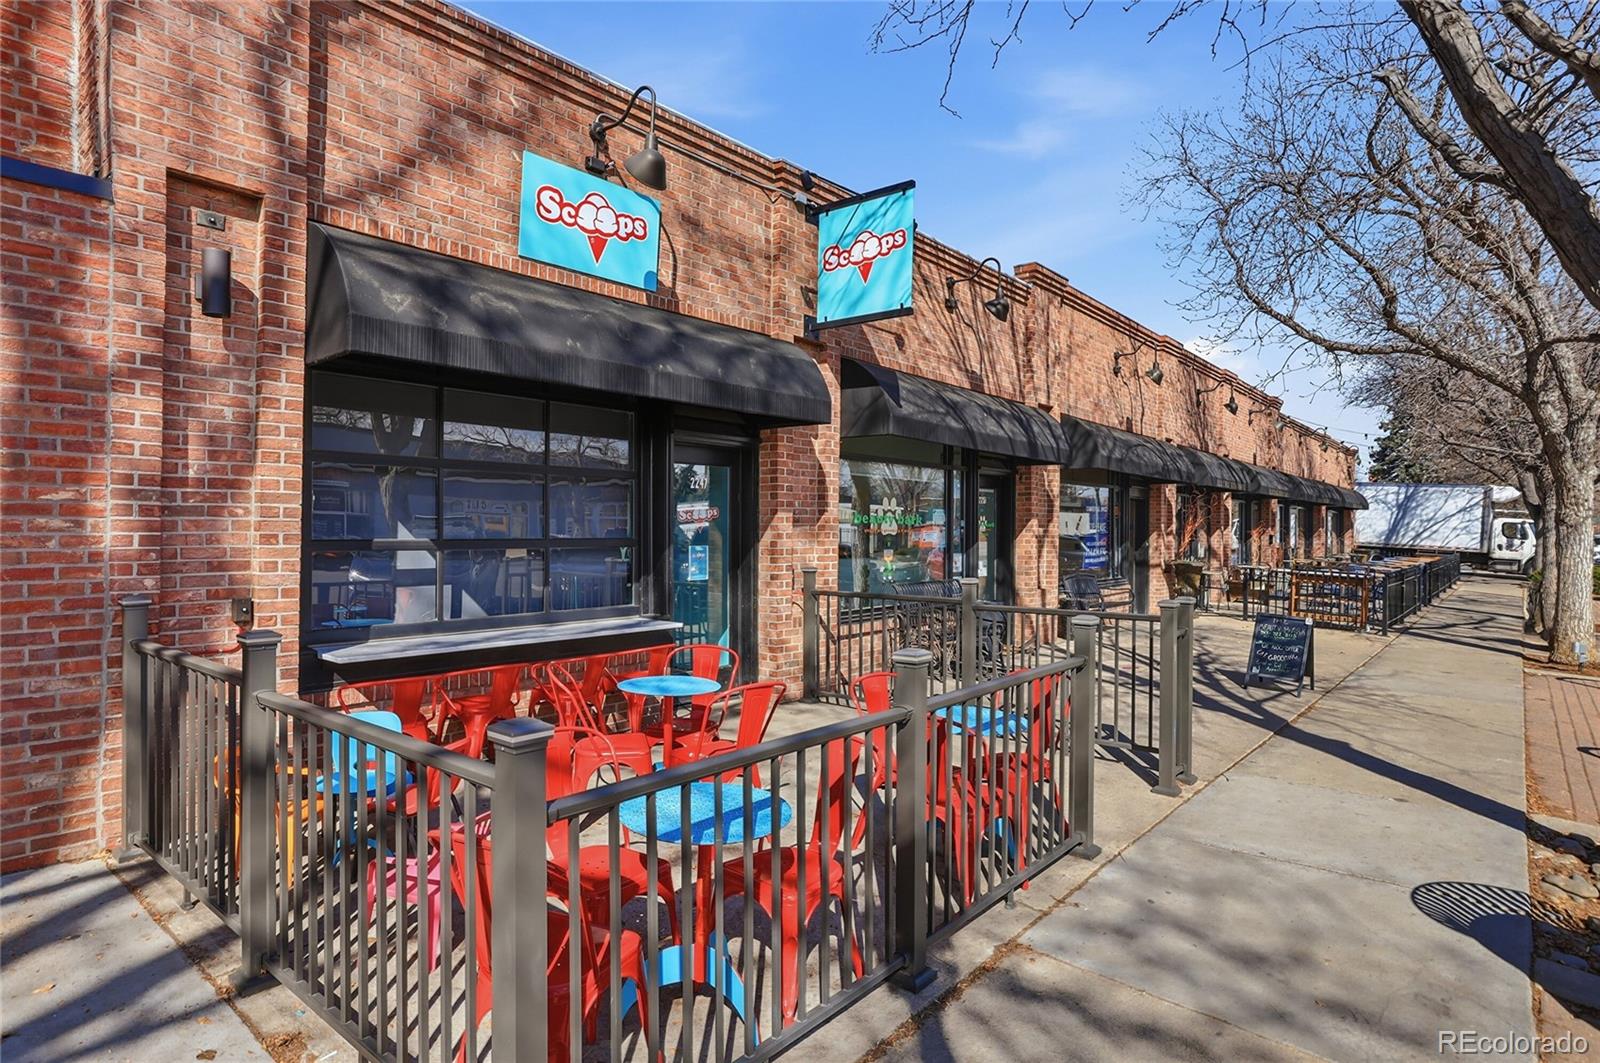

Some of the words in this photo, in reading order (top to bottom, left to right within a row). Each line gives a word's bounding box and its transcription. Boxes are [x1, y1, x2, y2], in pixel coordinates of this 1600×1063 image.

[535, 185, 649, 242] Scoops
[822, 229, 907, 272] Scoops
[690, 477, 708, 489] 2247
[677, 507, 720, 523] Scoops
